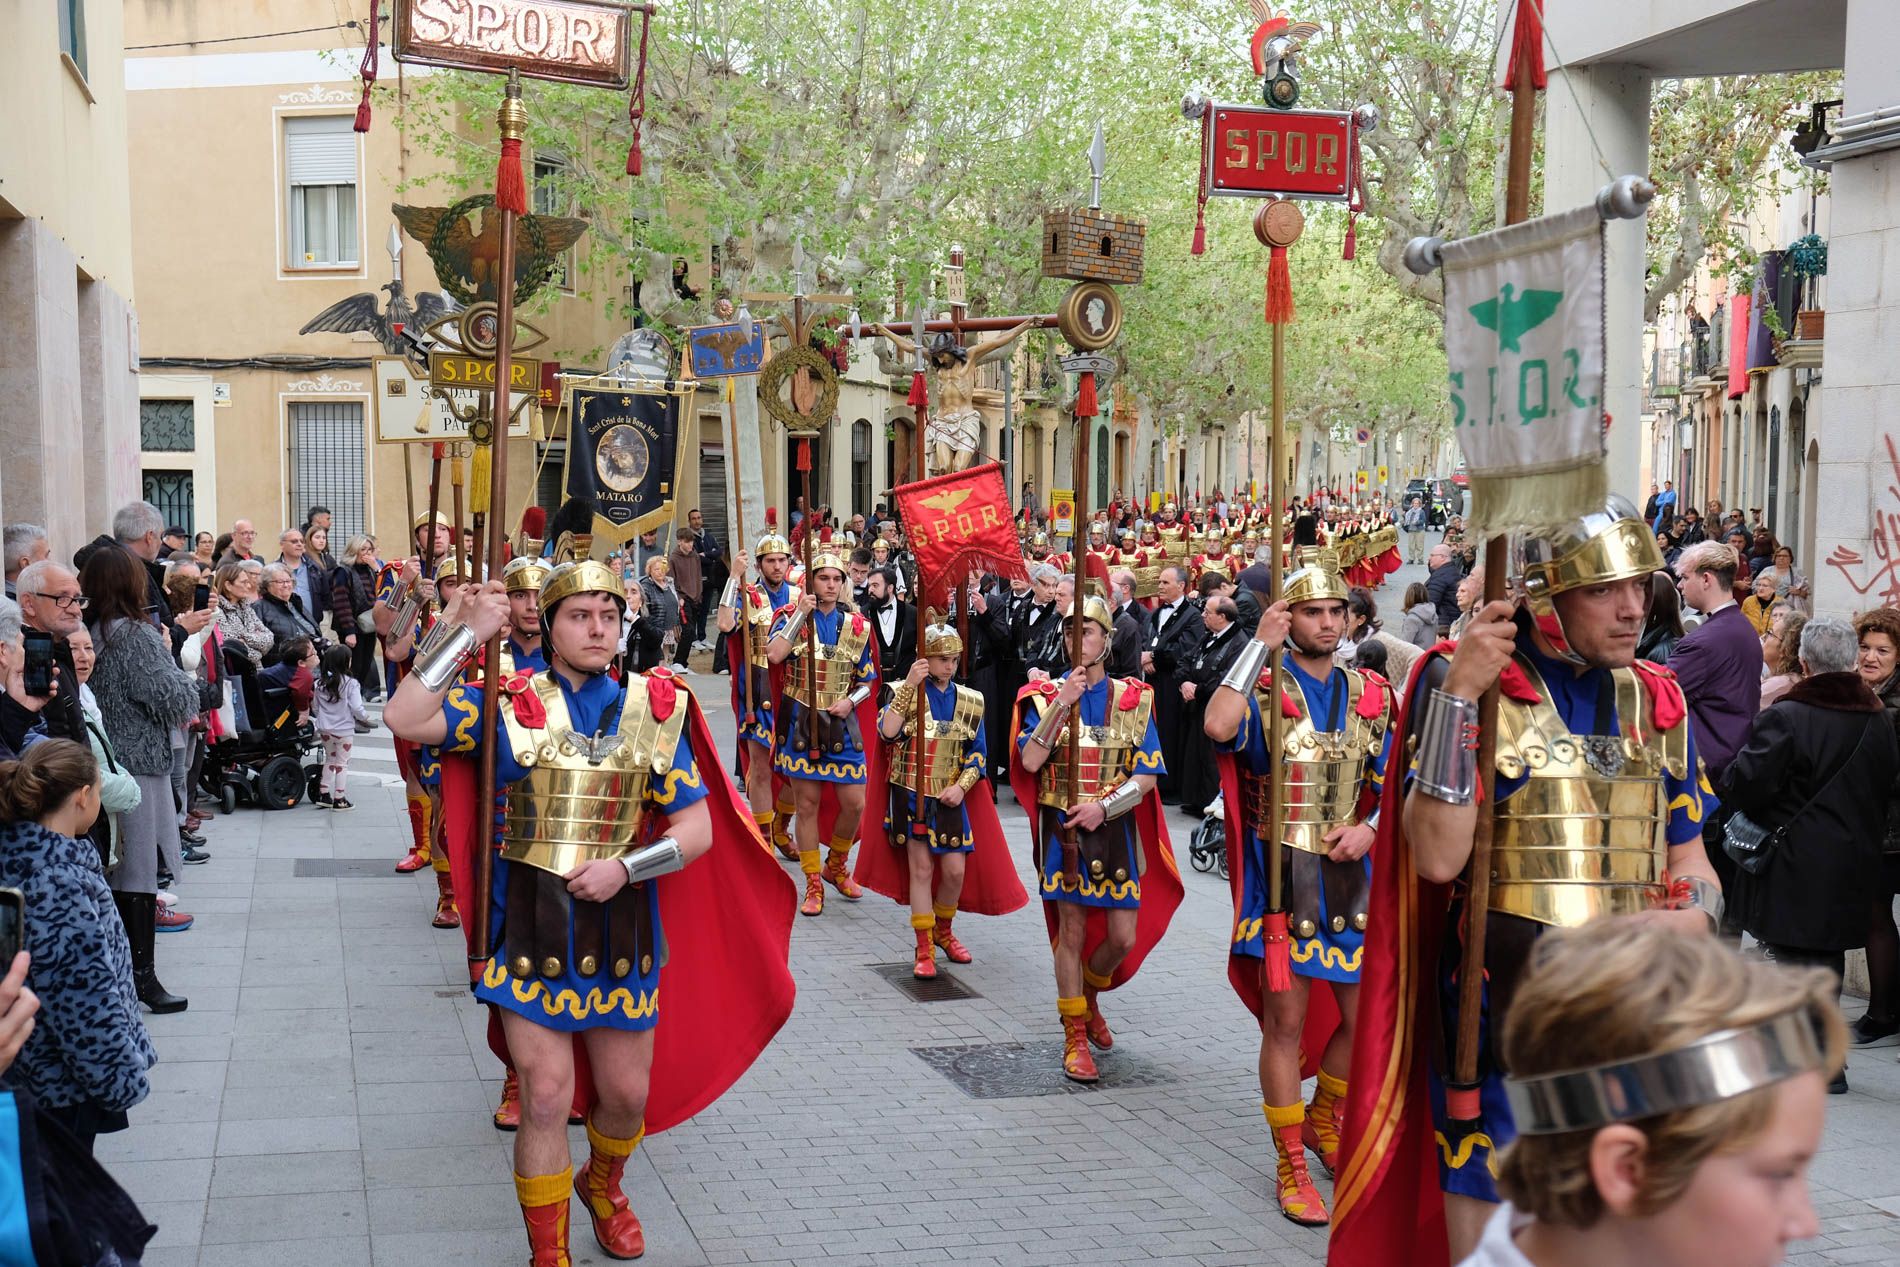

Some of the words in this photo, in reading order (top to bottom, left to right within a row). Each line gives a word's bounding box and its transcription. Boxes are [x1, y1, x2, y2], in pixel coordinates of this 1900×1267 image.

[1226, 129, 1338, 175] SPQR
[441, 360, 531, 386] S.P.R.
[588, 422, 602, 436] Sant
[616, 415, 625, 424] de
[625, 415, 632, 424] la
[632, 416, 647, 430] Bona
[596, 490, 643, 503] MATARÓ
[912, 504, 1004, 548] S.P.Q.R.
